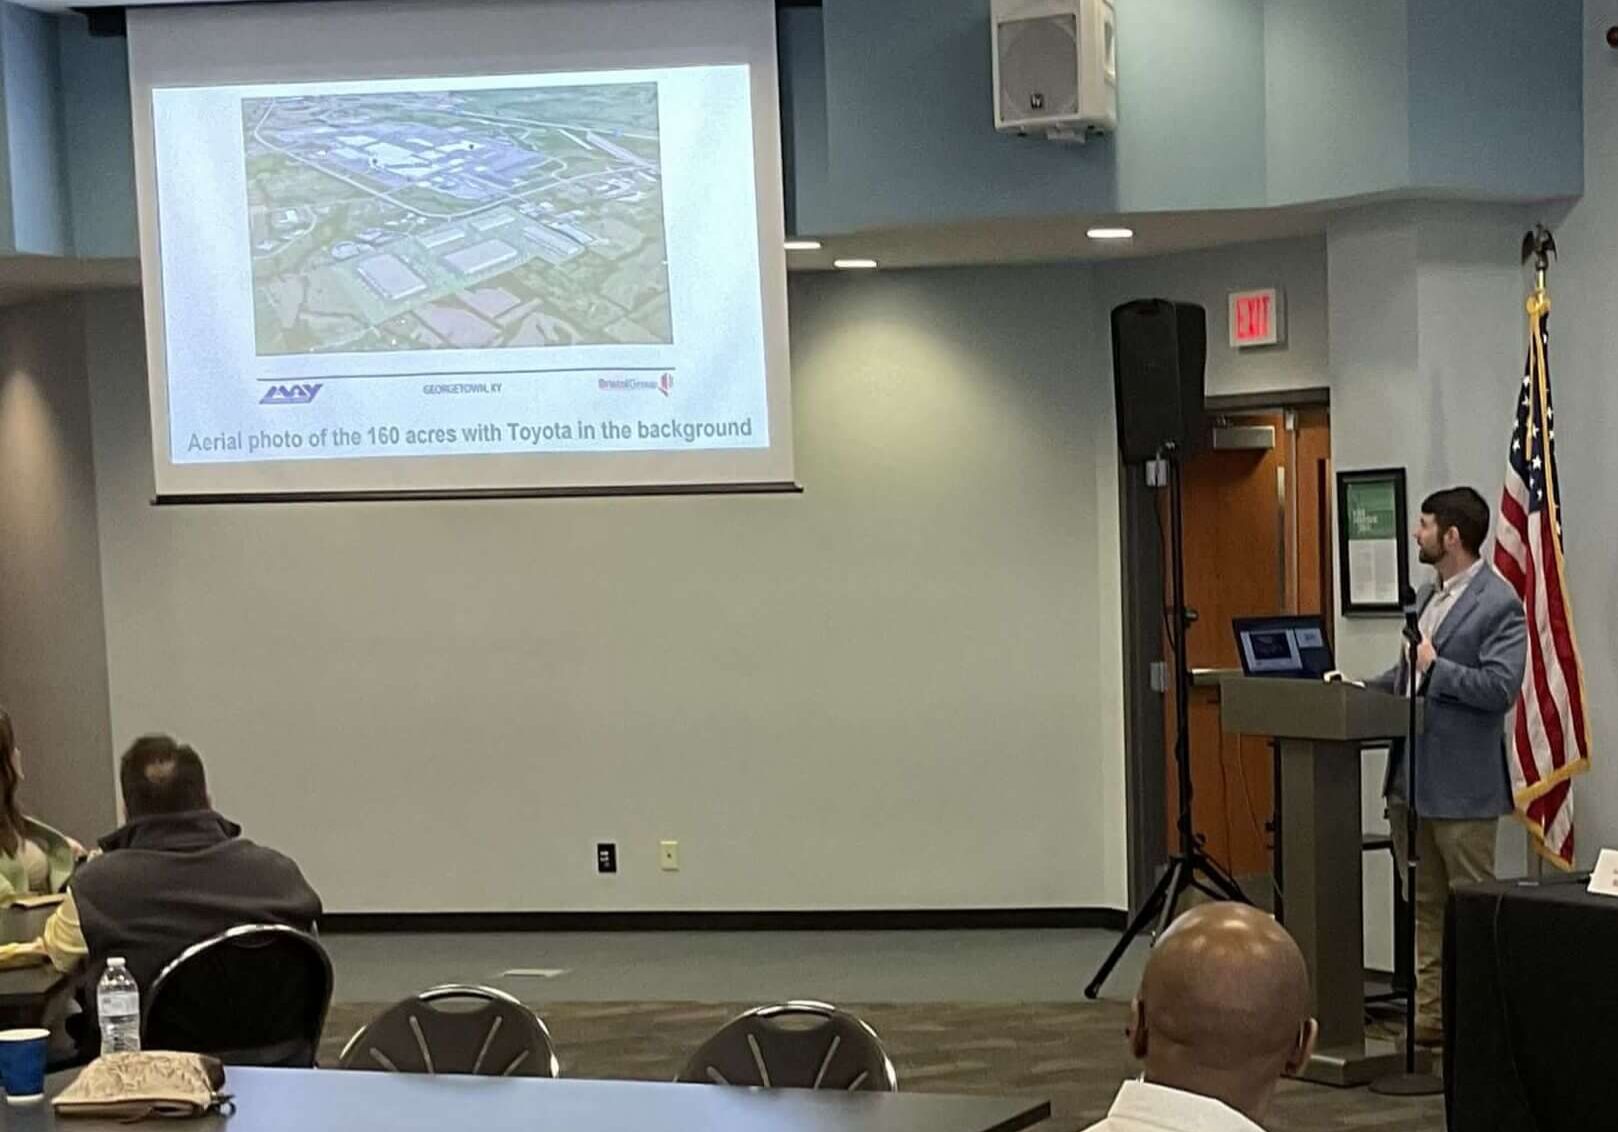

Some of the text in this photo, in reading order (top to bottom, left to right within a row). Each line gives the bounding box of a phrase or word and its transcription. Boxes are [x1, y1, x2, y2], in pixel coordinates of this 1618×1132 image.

[1235, 295, 1270, 339] EXIT
[490, 382, 502, 393] KY
[188, 417, 752, 453] Aerial photo of the 160 acres with Toyota in the background
